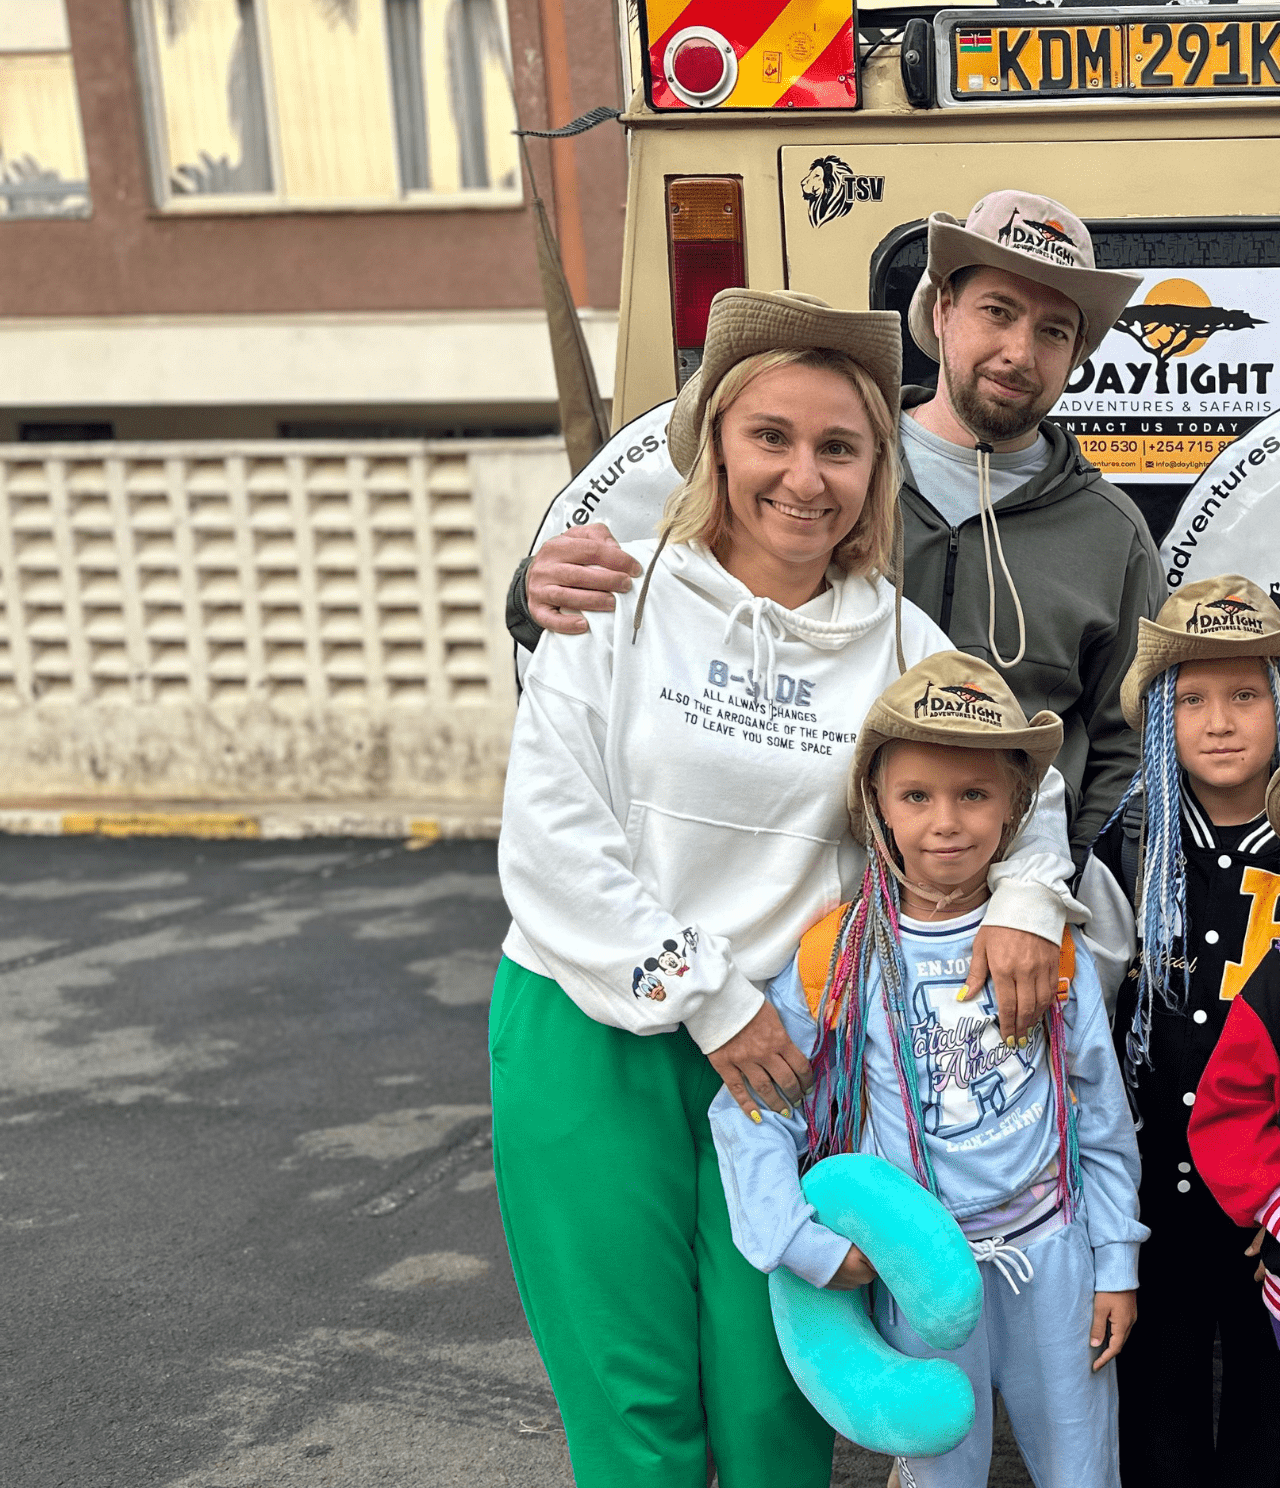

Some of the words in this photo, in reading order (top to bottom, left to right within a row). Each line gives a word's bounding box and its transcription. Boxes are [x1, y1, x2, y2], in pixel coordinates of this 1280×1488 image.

[999, 27, 1111, 92] KDM
[844, 176, 884, 201] TSV
[1059, 400, 1174, 412] ADVENTURES
[1181, 400, 1192, 412] &
[1199, 400, 1272, 412] SAFARIS
[1140, 422, 1164, 433] US
[1176, 422, 1239, 433] TODAY
[1082, 440, 1107, 452] 120
[1110, 440, 1138, 452] 530
[1149, 440, 1184, 453] +254
[1187, 440, 1214, 453] 715
[659, 687, 690, 706] ALSO
[694, 699, 713, 716] THE
[716, 708, 780, 733] ARROGANCE
[783, 724, 797, 736] OF
[800, 726, 819, 739] THE
[822, 730, 857, 744] POWER
[702, 688, 725, 704] ALL
[728, 697, 767, 715] ALWAYS
[771, 706, 818, 723] CHANGES
[684, 711, 698, 725] TO
[702, 717, 736, 738] LEAVE
[742, 729, 763, 744] YOU
[766, 735, 796, 750] SOME
[800, 741, 834, 756] SPACE
[910, 1016, 991, 1059] Totally
